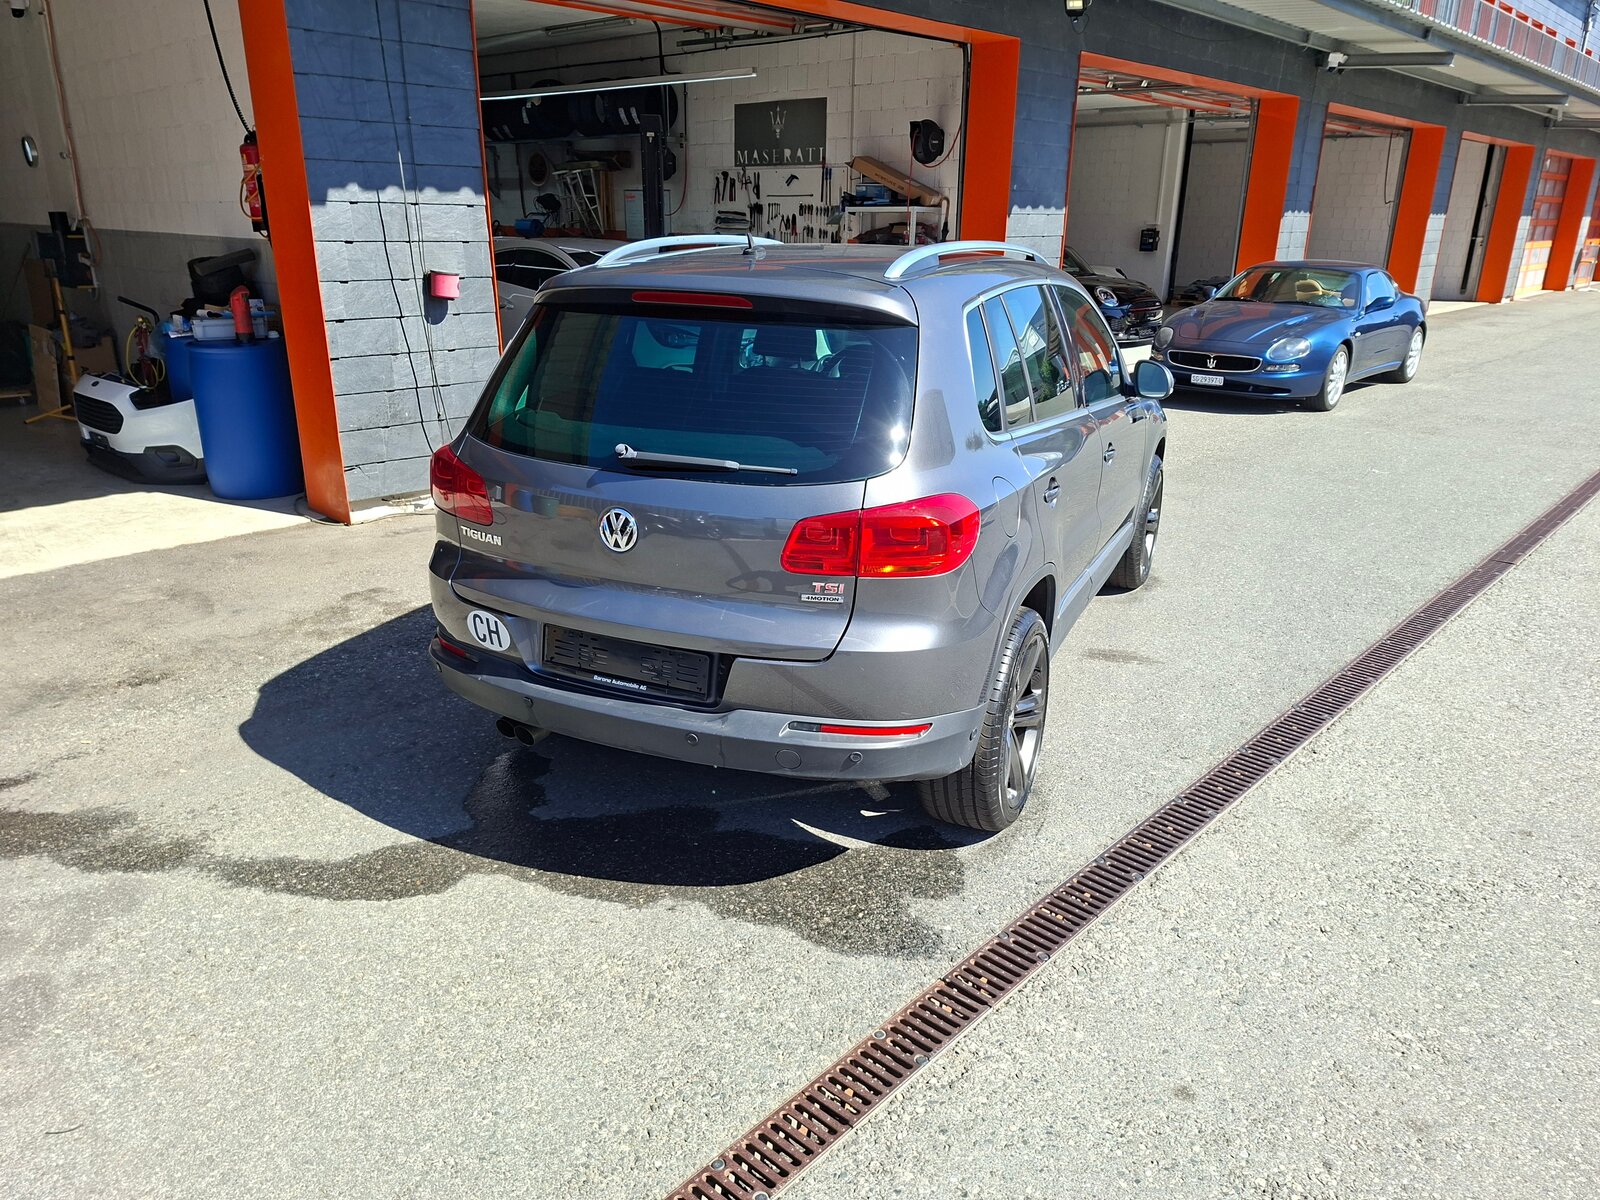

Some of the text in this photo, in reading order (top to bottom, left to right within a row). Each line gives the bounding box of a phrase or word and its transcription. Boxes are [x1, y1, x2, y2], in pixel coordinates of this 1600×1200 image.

[736, 147, 824, 165] MASERATI
[460, 525, 502, 546] TIGUAN
[601, 509, 637, 551] VW
[812, 582, 844, 594] TSI
[472, 613, 503, 648] CH
[611, 679, 640, 689] Automobile
